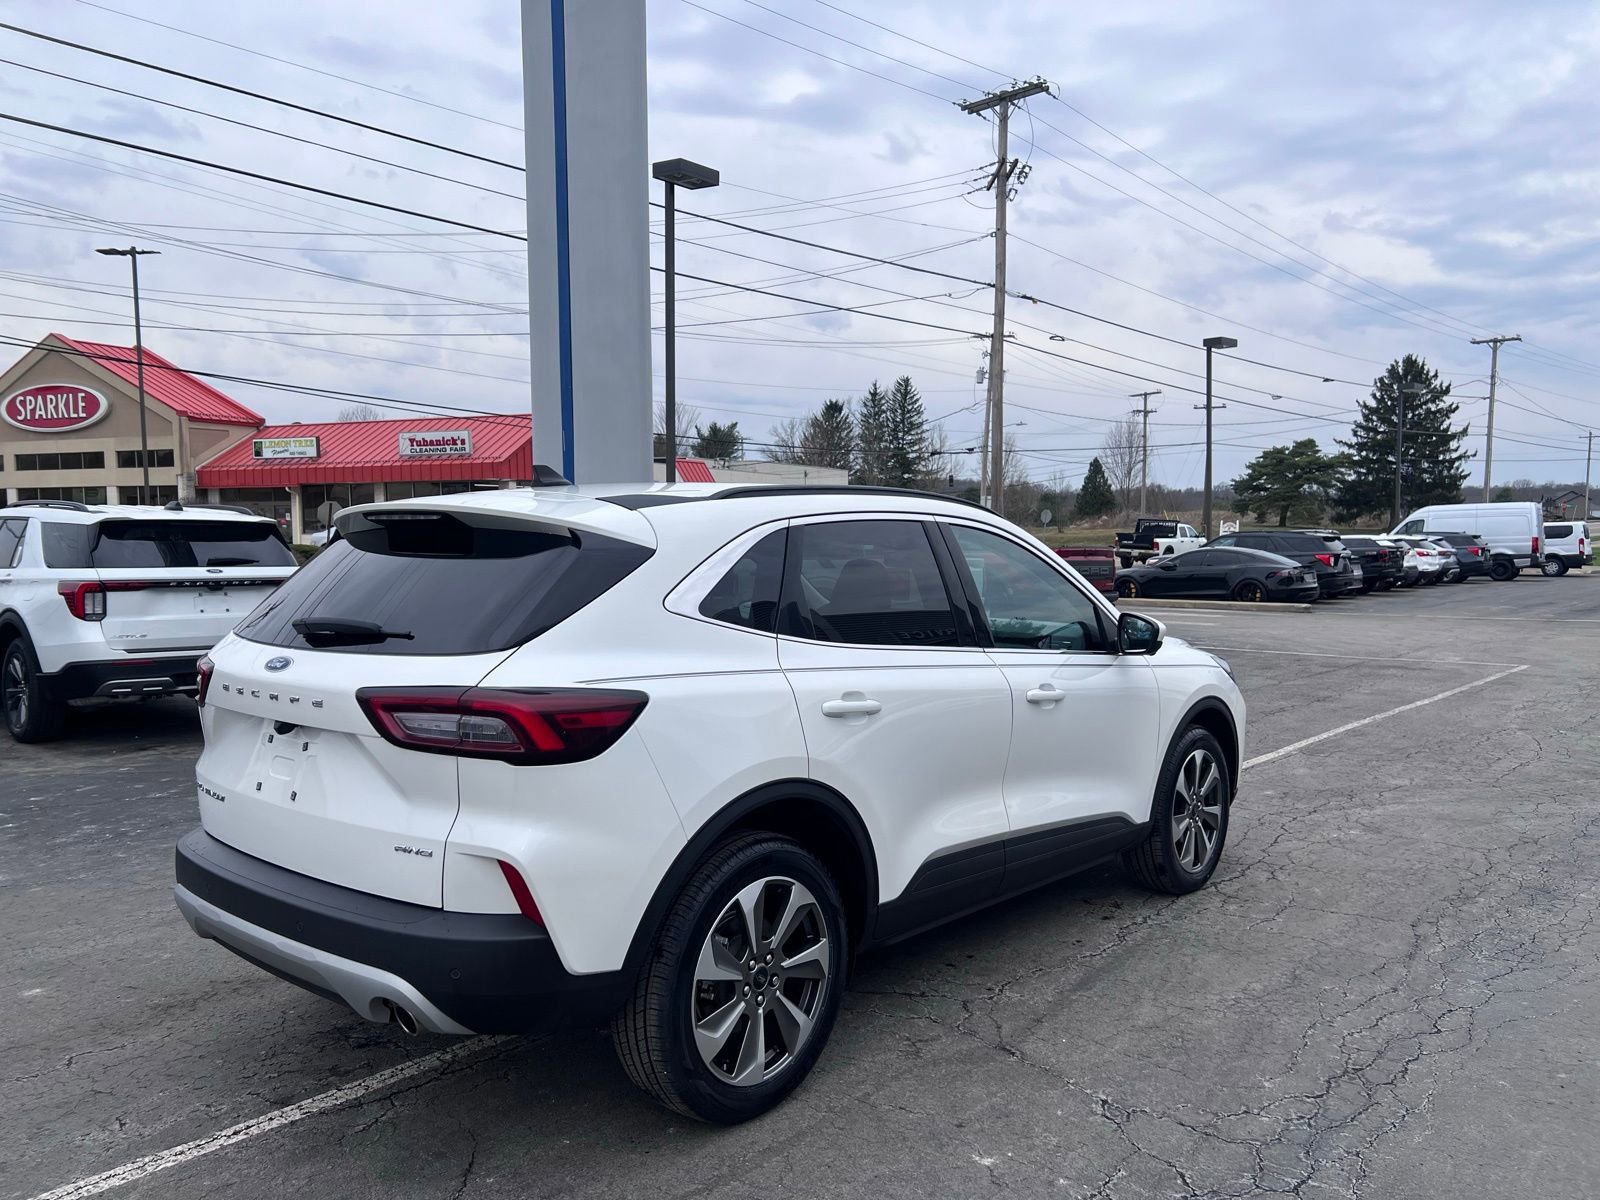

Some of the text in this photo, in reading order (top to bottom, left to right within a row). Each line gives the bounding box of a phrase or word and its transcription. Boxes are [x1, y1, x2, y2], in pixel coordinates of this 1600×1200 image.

[15, 392, 87, 421] SPARKLE
[263, 439, 314, 448] LEMON TREE
[409, 446, 447, 454] CLEANING
[222, 682, 324, 708] ESCAPE
